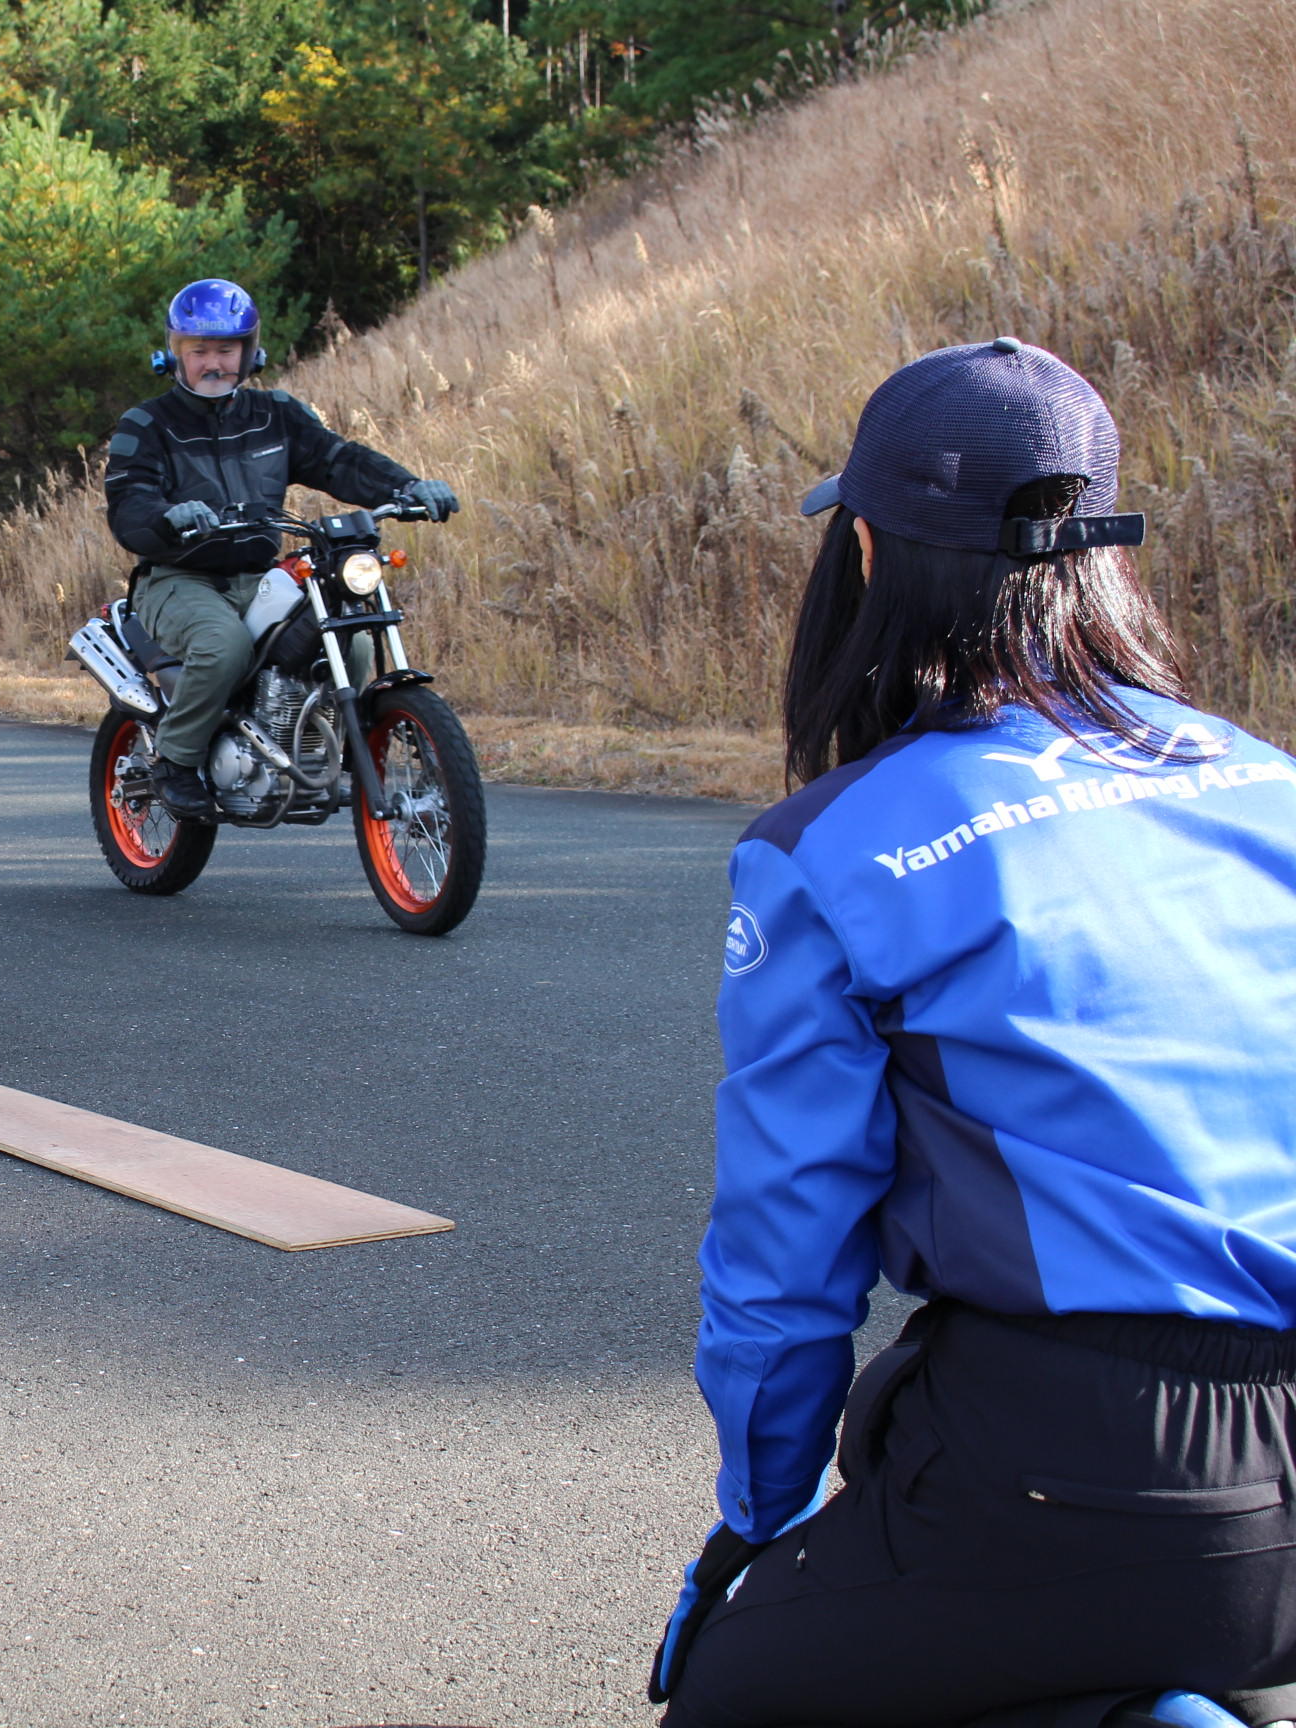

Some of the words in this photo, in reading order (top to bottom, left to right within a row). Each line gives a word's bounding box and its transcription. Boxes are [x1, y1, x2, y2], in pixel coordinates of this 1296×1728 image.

[196, 320, 229, 331] SHOEI
[873, 795, 1060, 879] Yamaha
[1056, 773, 1200, 812] Riding
